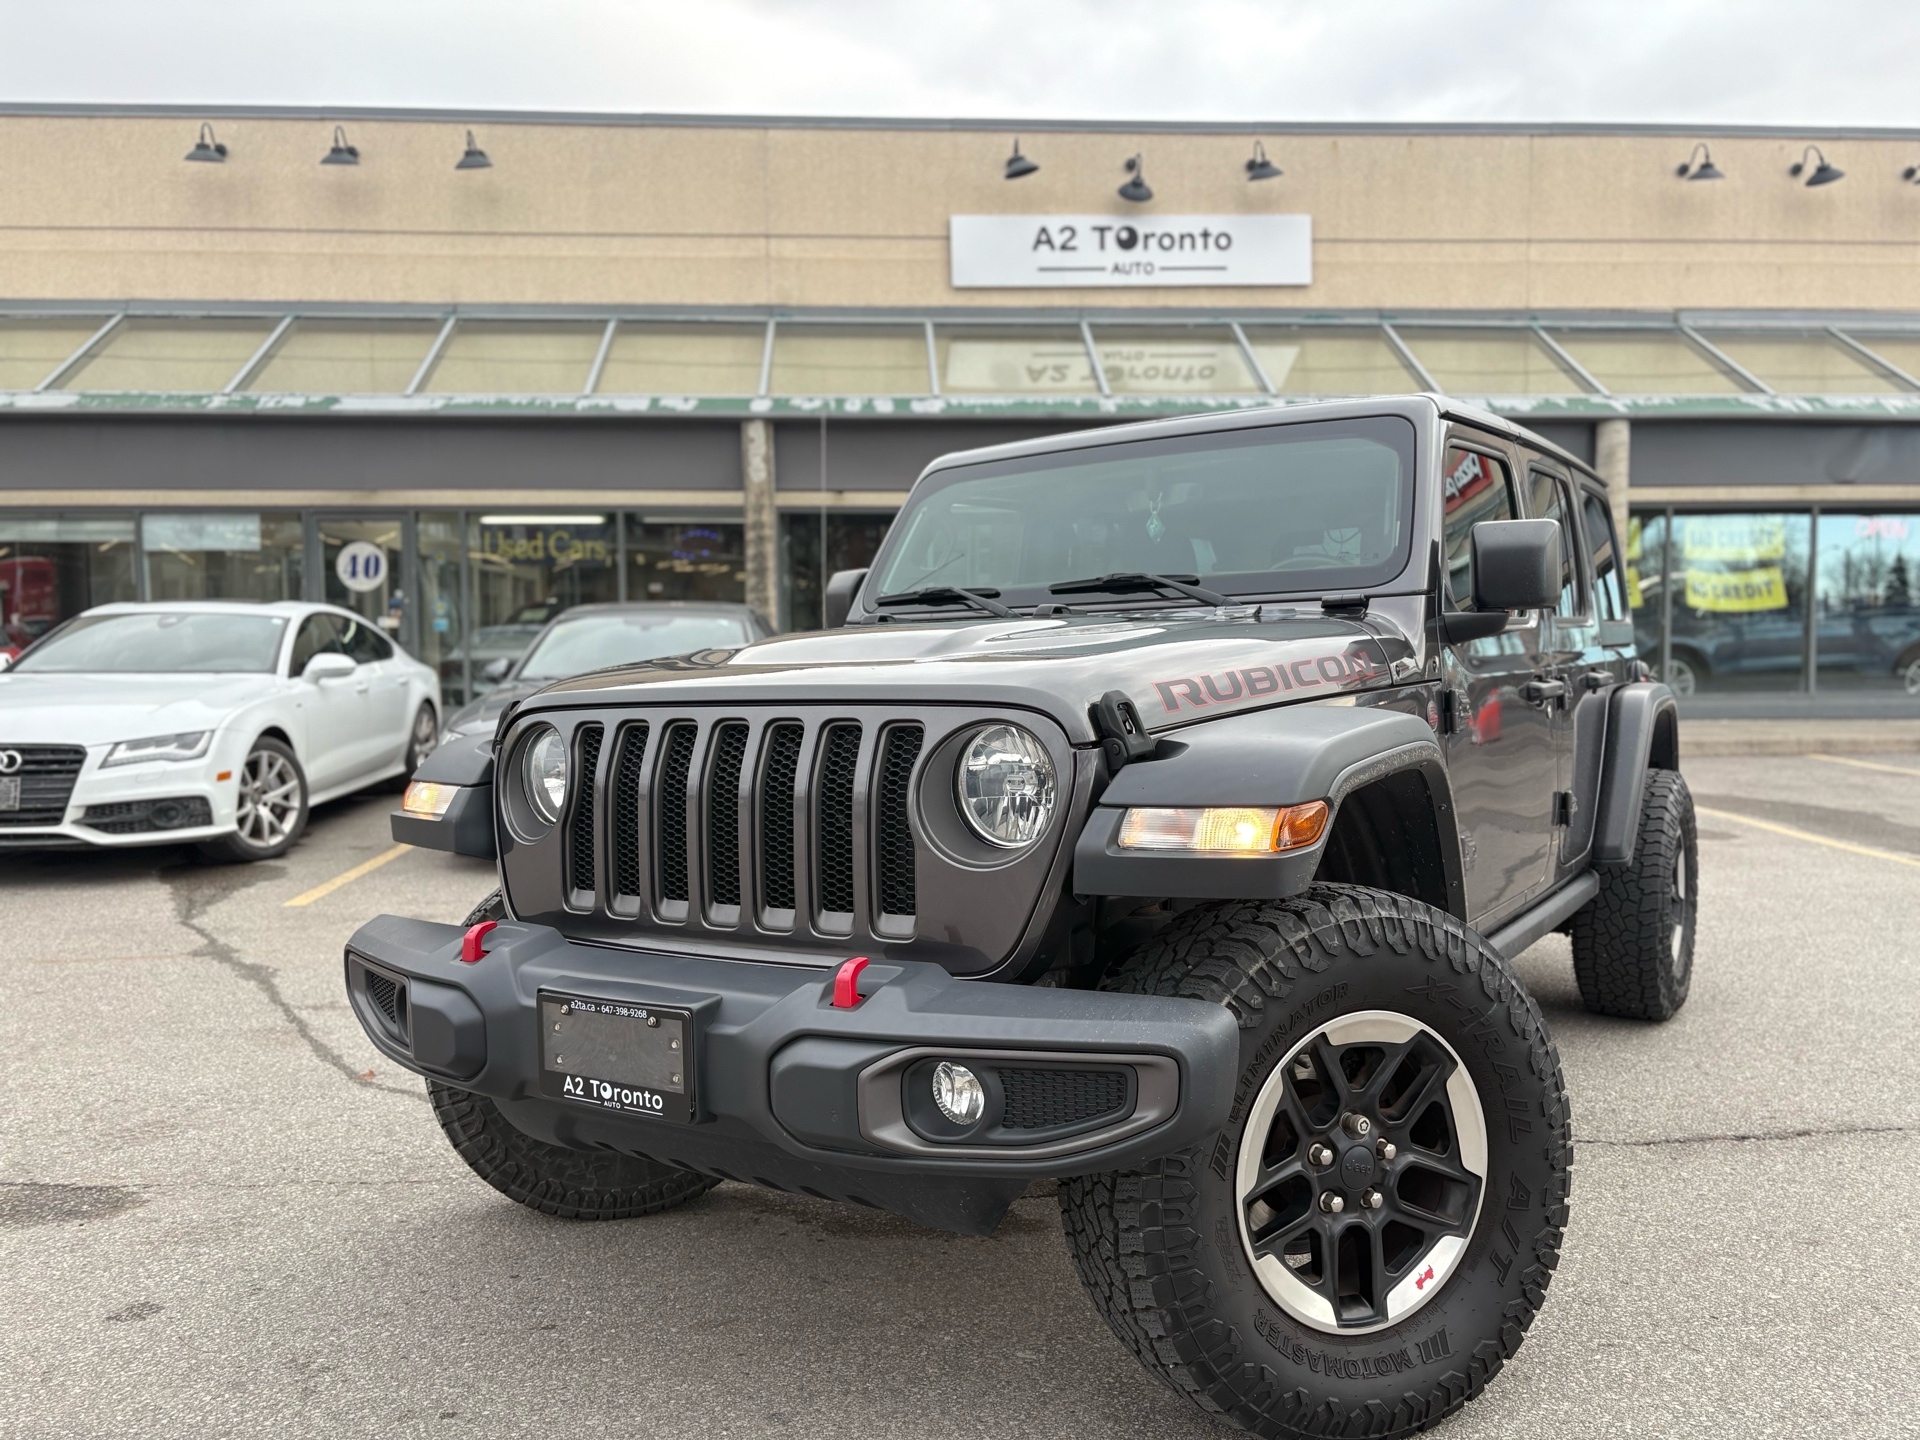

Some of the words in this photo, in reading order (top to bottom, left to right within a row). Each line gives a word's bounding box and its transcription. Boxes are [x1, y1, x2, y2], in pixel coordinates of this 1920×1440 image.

[1032, 225, 1078, 252] A2
[1110, 262, 1155, 276] AUTO
[481, 530, 543, 559] Used
[548, 530, 606, 560] Cars
[343, 553, 381, 580] 40
[1711, 579, 1774, 601] CREDIT
[1151, 650, 1378, 713] RUBICON
[570, 1000, 596, 1012] a2ta.ca
[601, 1004, 647, 1019] 647-398-9268
[1228, 980, 1350, 1125] ELIMINATOR
[563, 1075, 585, 1096] A2
[603, 1100, 621, 1109] AUTO
[1345, 1159, 1372, 1177] Jeep
[1253, 1308, 1418, 1380] MOTOMASTER
